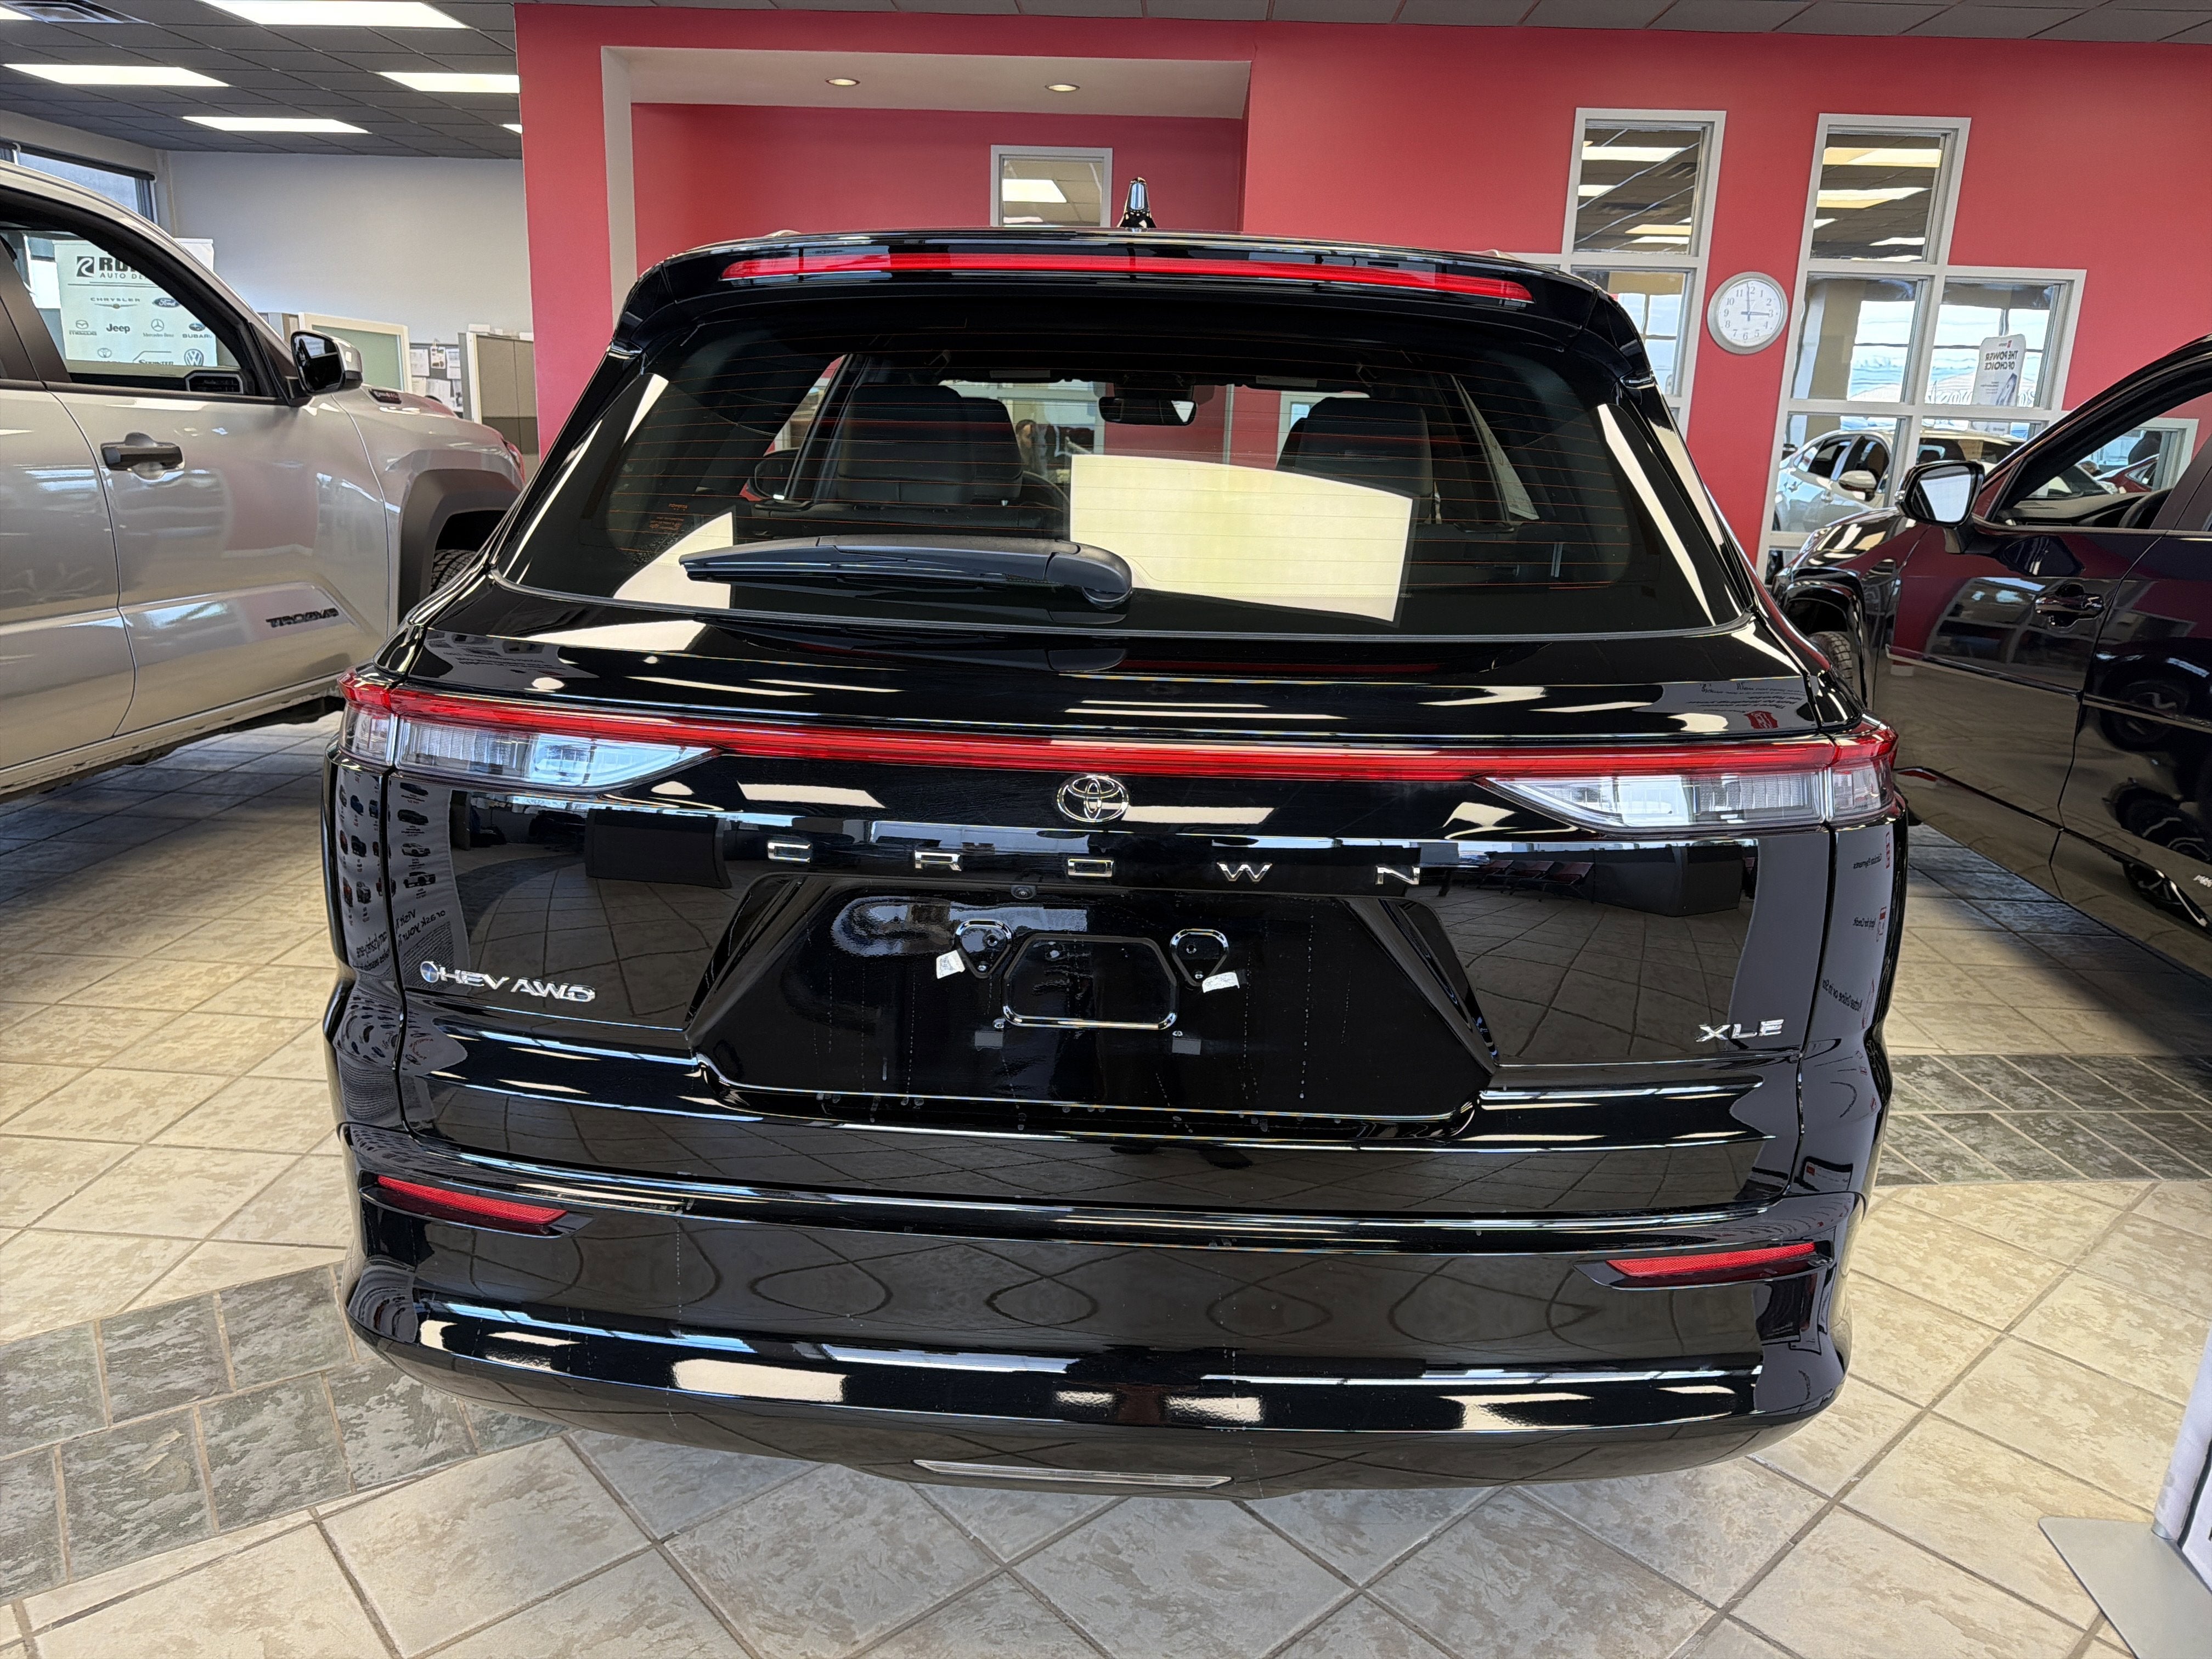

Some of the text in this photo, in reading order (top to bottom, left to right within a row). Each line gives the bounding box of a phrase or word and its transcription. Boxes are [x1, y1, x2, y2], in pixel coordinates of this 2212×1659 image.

[99, 257, 138, 272] RU
[1736, 289, 1743, 297] 11
[157, 297, 176, 307] Ford
[1726, 297, 1735, 306] 10
[1766, 298, 1771, 306] 2
[1724, 308, 1729, 317] 9
[1768, 309, 1774, 318] 3
[106, 323, 131, 334] Jeep
[1725, 320, 1731, 328] 8
[1763, 321, 1768, 329] 4
[1742, 332, 1748, 341] 6
[1754, 329, 1760, 337] 5
[768, 842, 1420, 885] CROWN
[439, 966, 596, 1003] HEV AWD
[1695, 1018, 1785, 1043] XLE
